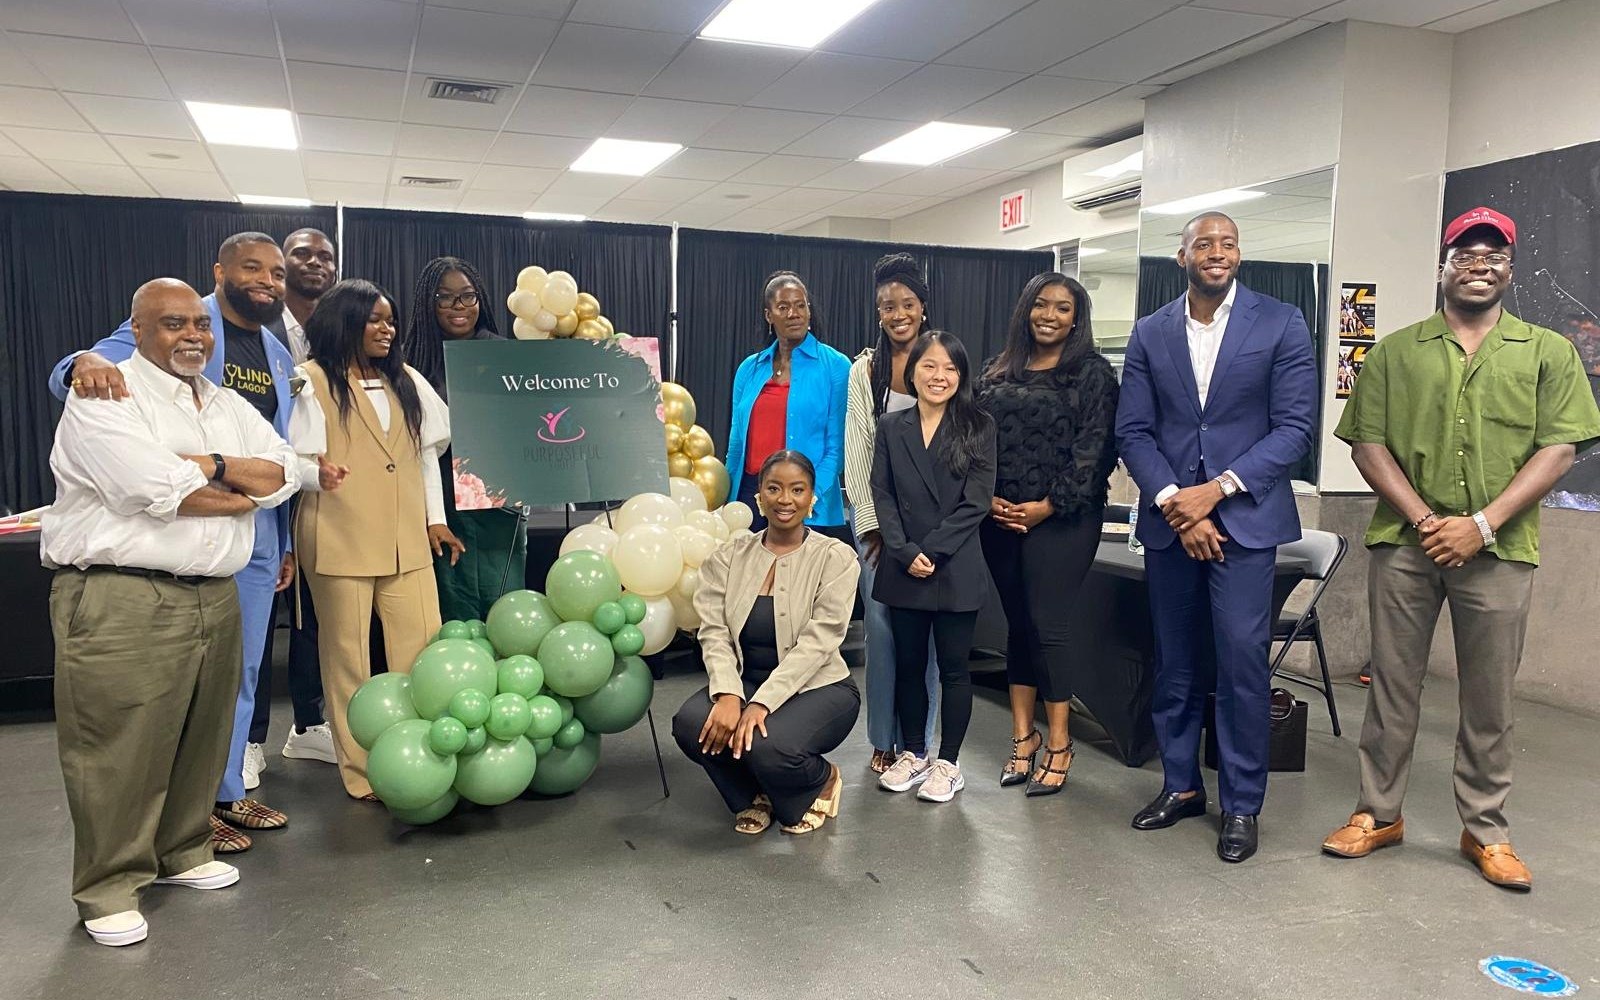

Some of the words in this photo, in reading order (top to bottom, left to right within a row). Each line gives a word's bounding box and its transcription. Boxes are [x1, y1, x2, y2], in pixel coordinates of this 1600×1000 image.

[1002, 195, 1023, 228] EXIT
[237, 381, 267, 395] LAGOS
[501, 373, 591, 392] Welcome
[593, 372, 619, 389] To
